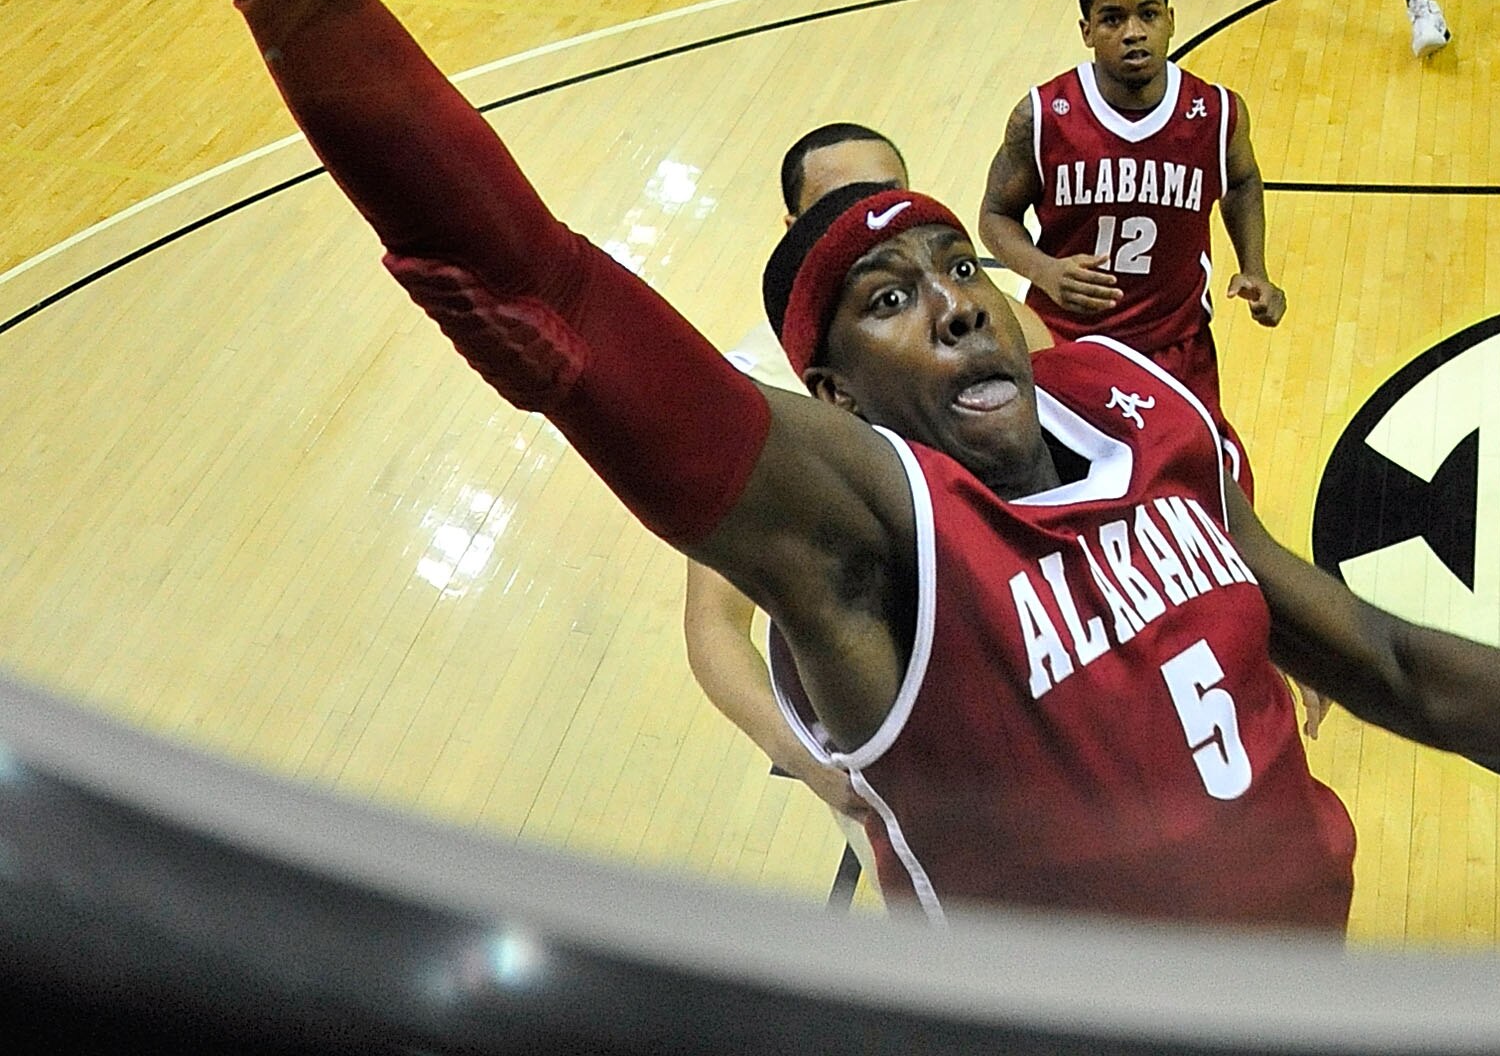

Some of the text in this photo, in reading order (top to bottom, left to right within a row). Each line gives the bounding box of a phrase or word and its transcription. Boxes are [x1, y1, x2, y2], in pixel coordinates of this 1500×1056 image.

[1055, 157, 1203, 212] ALABAMA
[1093, 215, 1158, 275] 12
[1009, 495, 1259, 700] ALABAMA
[1160, 638, 1253, 801] 5
